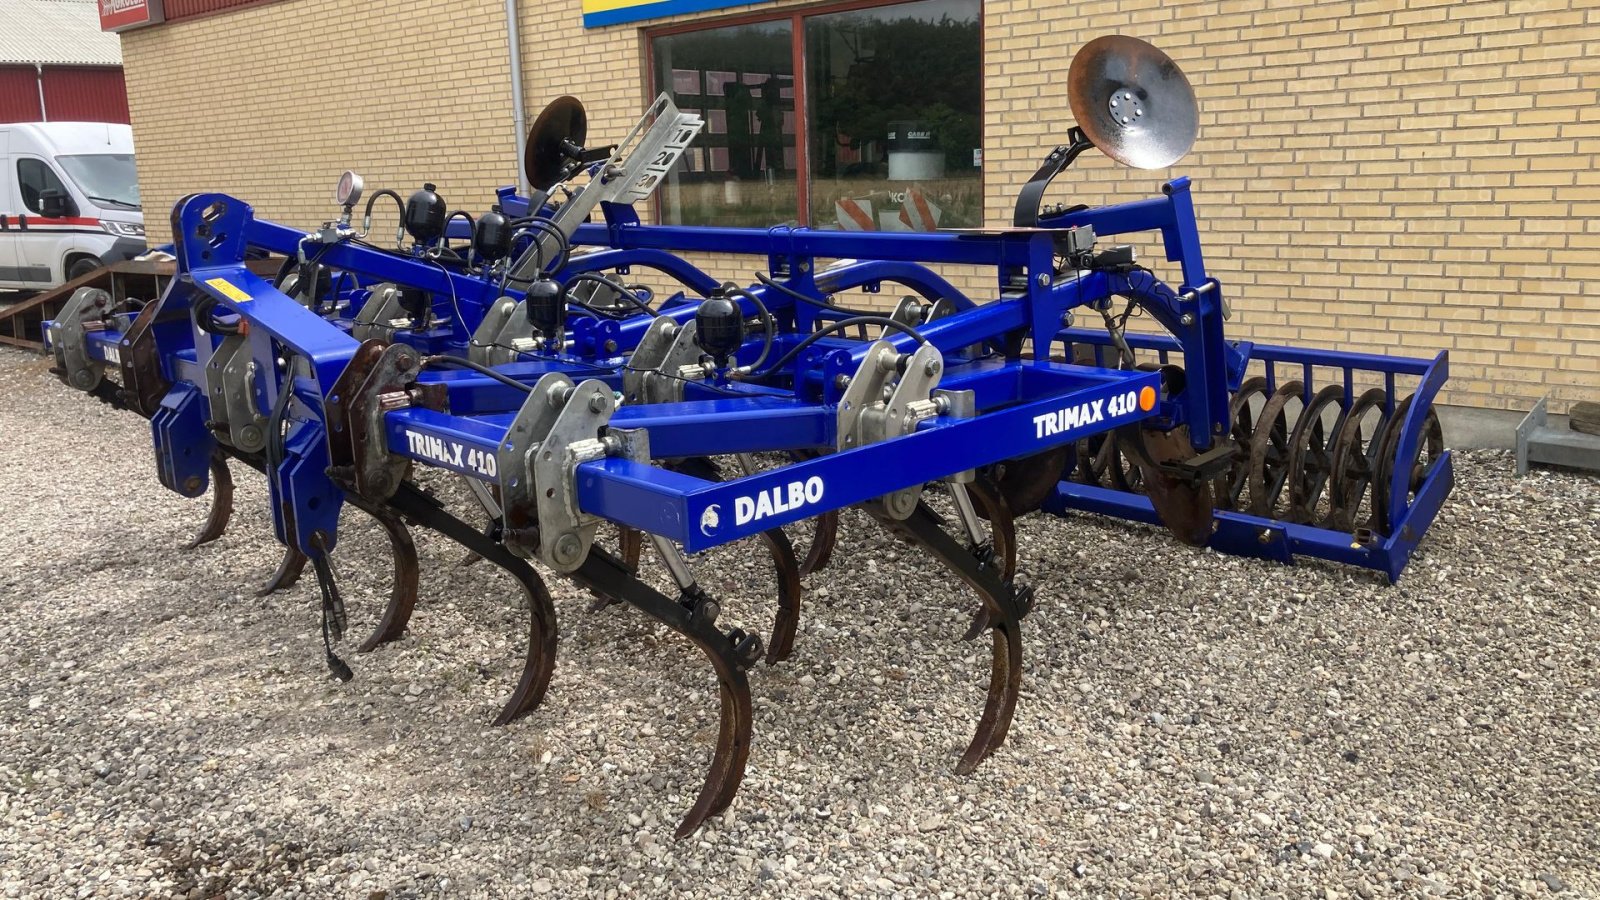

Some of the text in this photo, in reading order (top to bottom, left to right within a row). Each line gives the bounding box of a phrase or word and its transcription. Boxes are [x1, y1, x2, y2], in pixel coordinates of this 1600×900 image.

[672, 129, 693, 143] 10
[652, 151, 676, 166] 20
[635, 173, 657, 188] 30
[1033, 390, 1137, 439] TRIMAX 410
[405, 429, 497, 477] TRIMAX 410
[734, 475, 824, 526] DALBO
